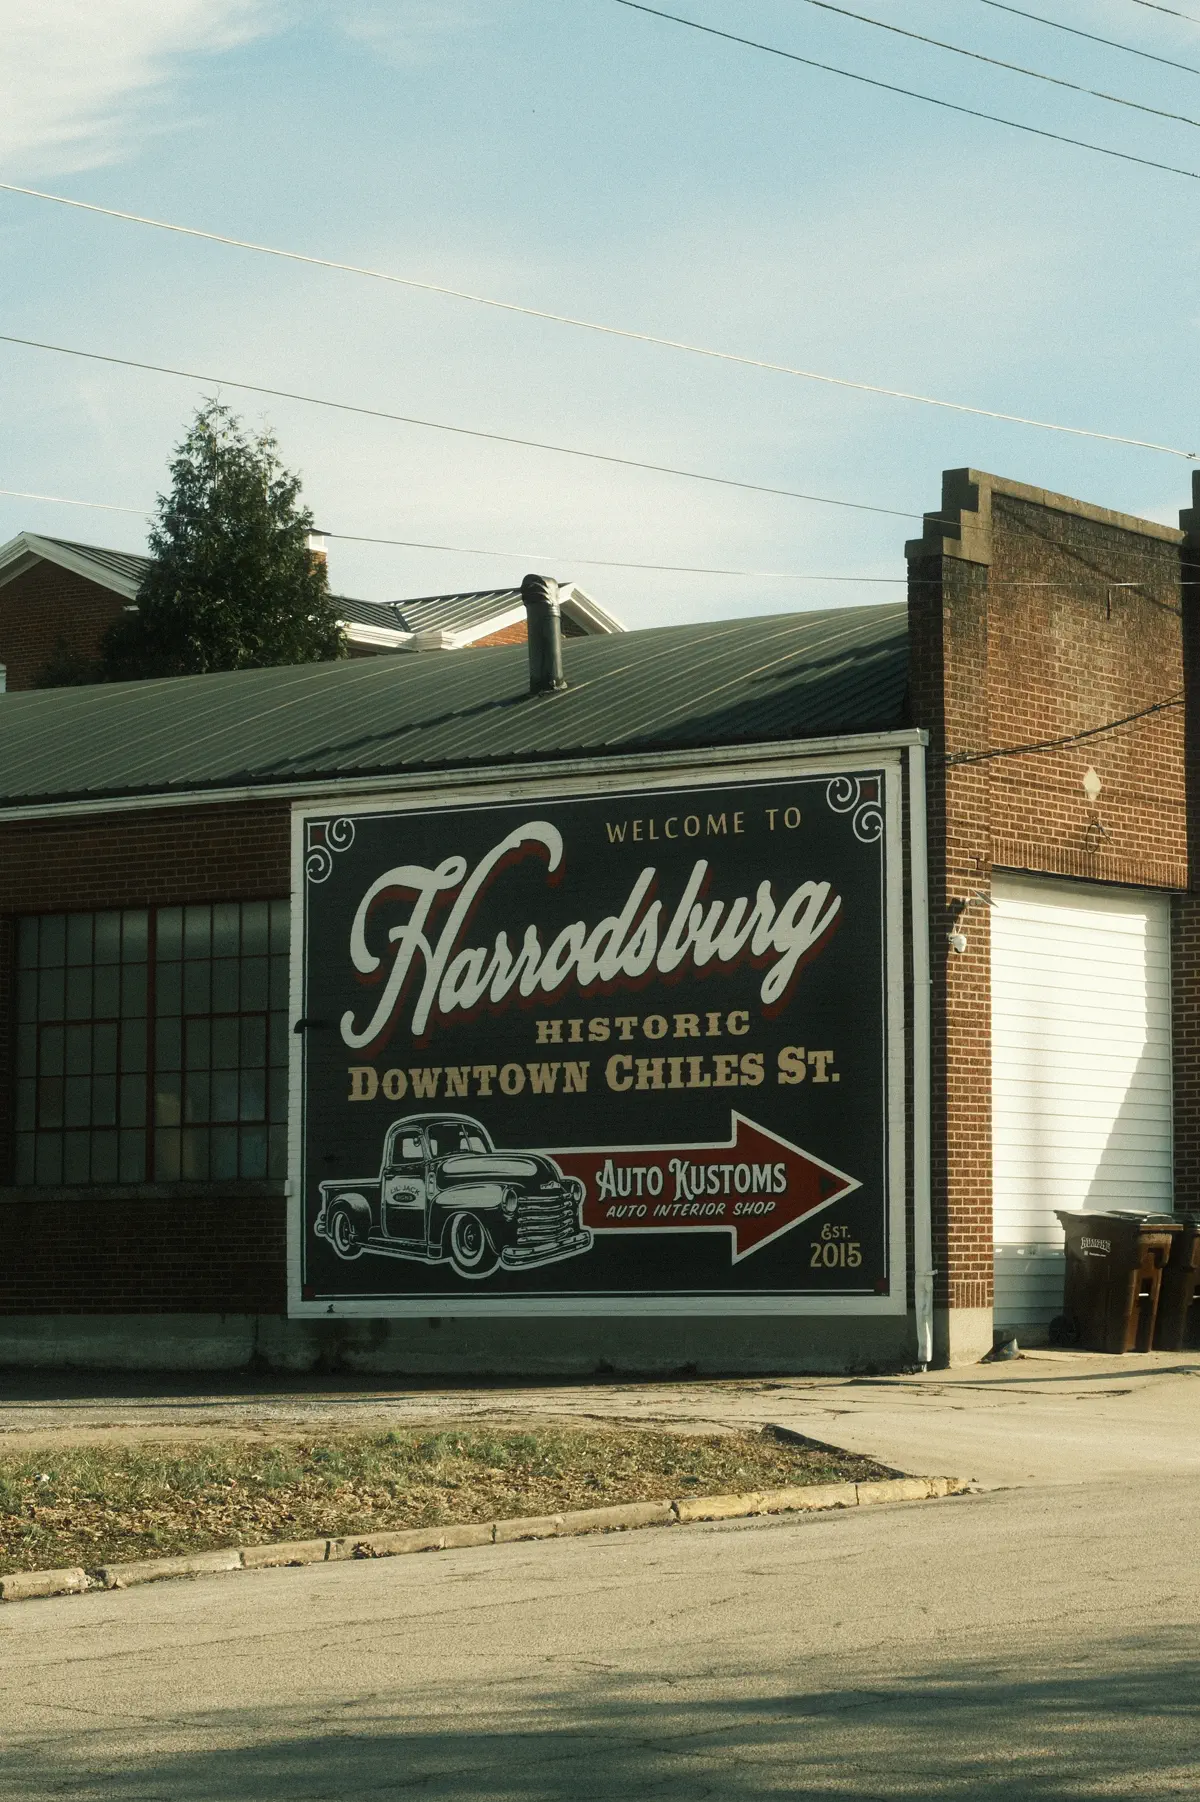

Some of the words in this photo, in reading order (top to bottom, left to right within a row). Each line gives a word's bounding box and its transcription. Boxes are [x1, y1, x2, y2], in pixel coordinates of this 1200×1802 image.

[606, 812, 745, 843] WELCOME
[765, 807, 801, 831] TO
[340, 820, 843, 1049] Harrodsburg
[535, 1011, 750, 1044] HISTORIC
[347, 1061, 591, 1102] DOWNTOWN
[604, 1053, 766, 1092] CHILES
[595, 1159, 664, 1202] AUTO
[668, 1158, 787, 1201] KUSTOMS
[606, 1204, 648, 1218] AUTO
[653, 1203, 726, 1217] INTERIOR
[732, 1201, 776, 1215] SHOP
[810, 1243, 862, 1267] 2015
